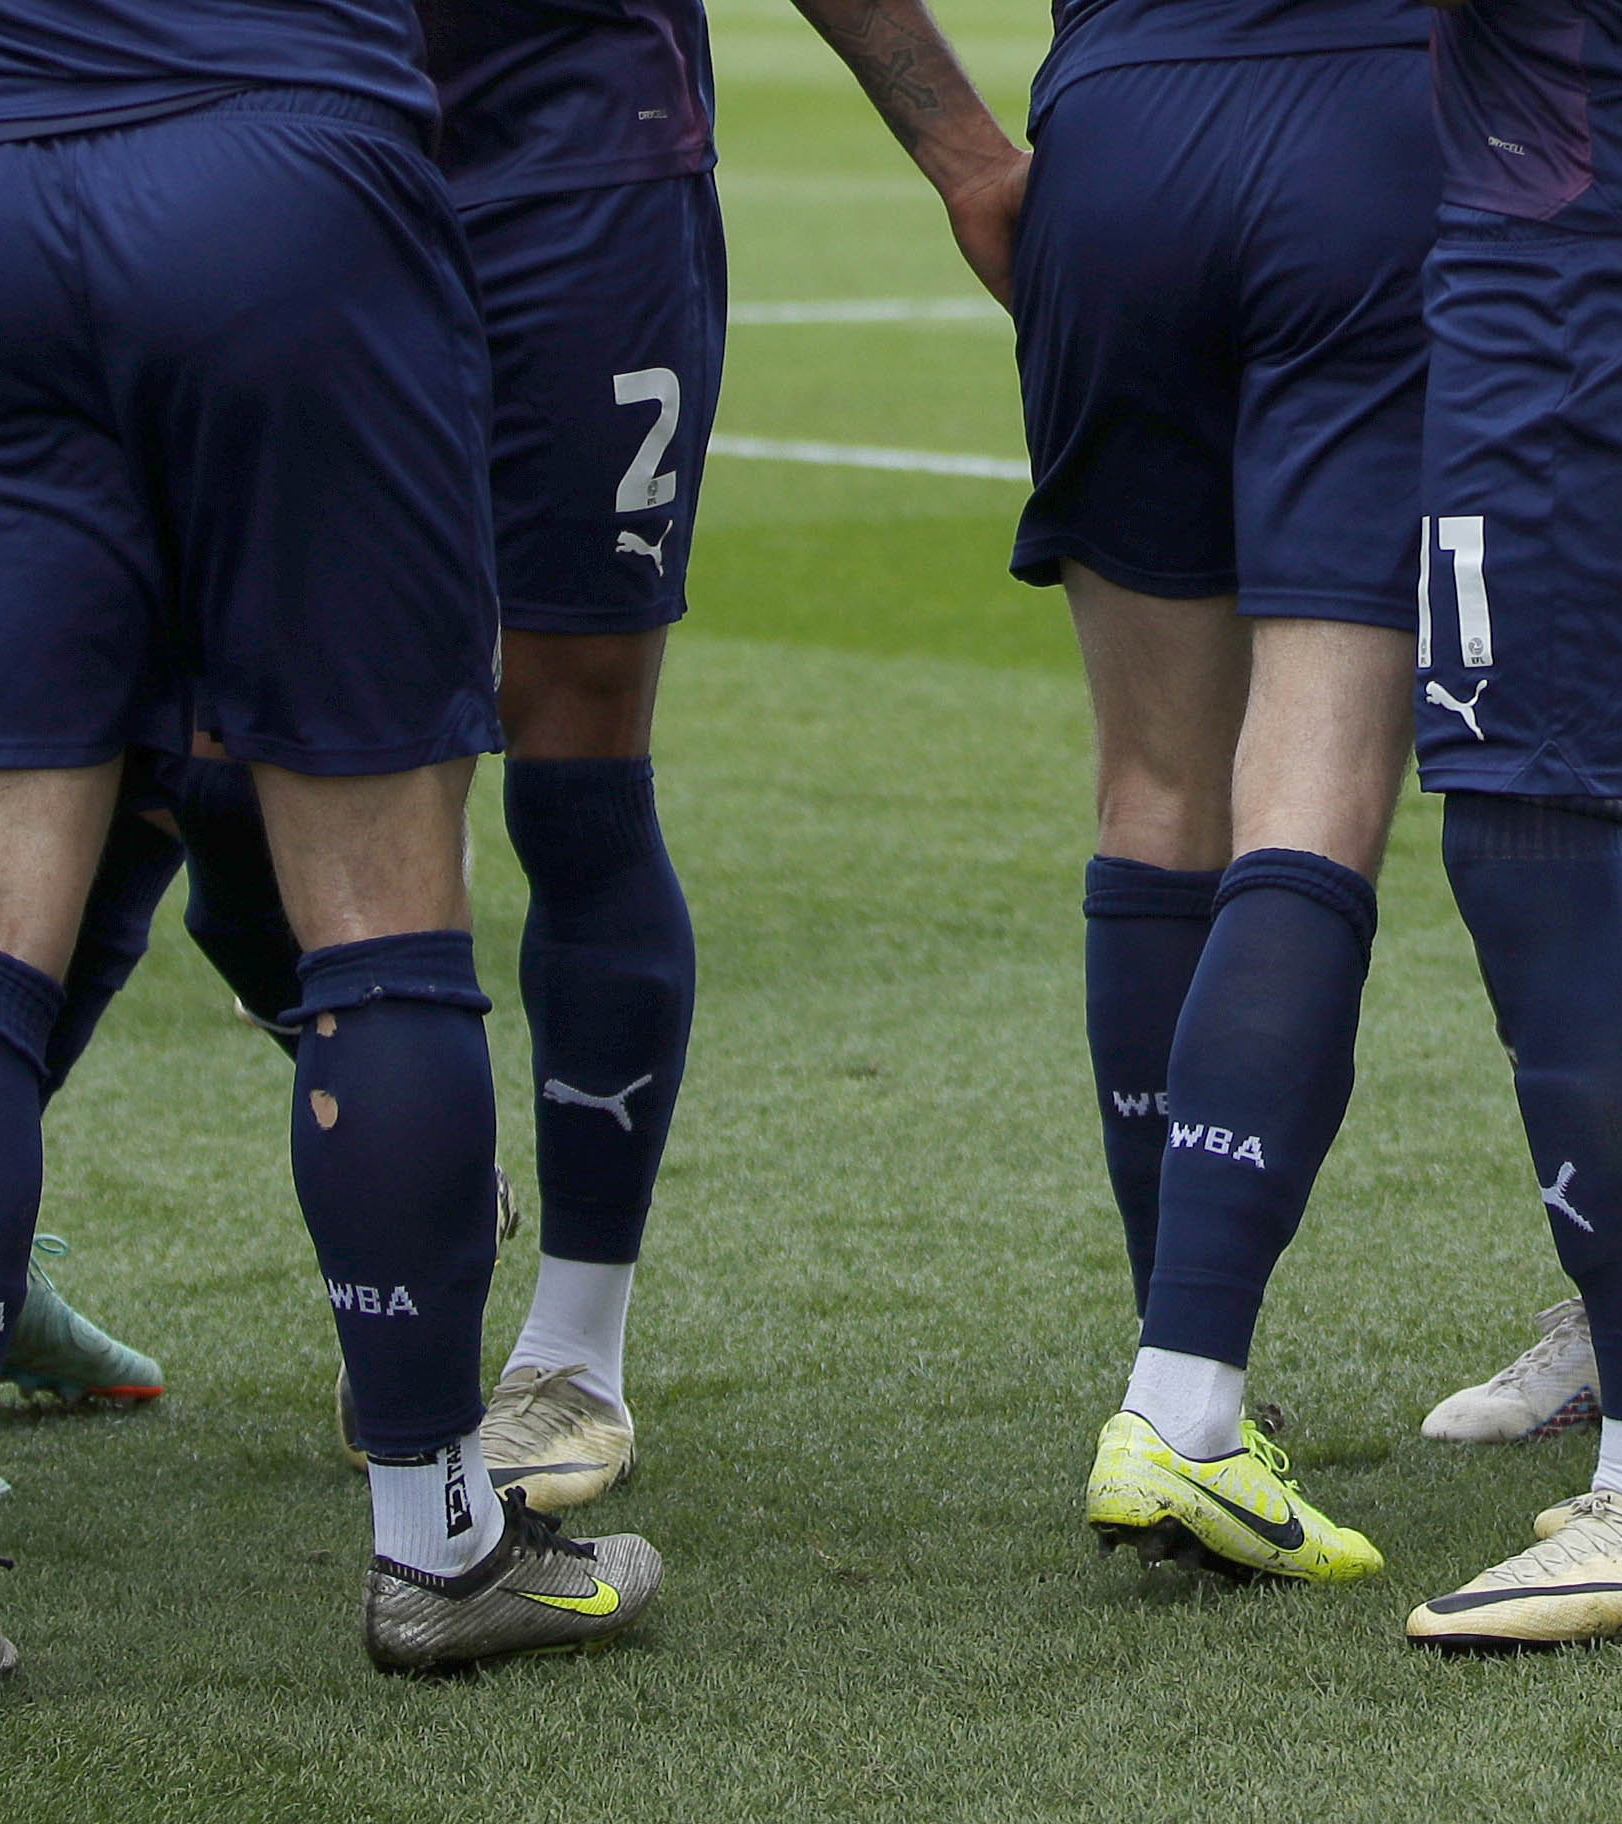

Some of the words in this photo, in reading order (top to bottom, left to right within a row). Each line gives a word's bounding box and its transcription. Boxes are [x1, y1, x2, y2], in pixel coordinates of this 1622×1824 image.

[612, 367, 680, 513] 2
[1171, 1122, 1266, 1169] WBA
[328, 1279, 419, 1317] WBA
